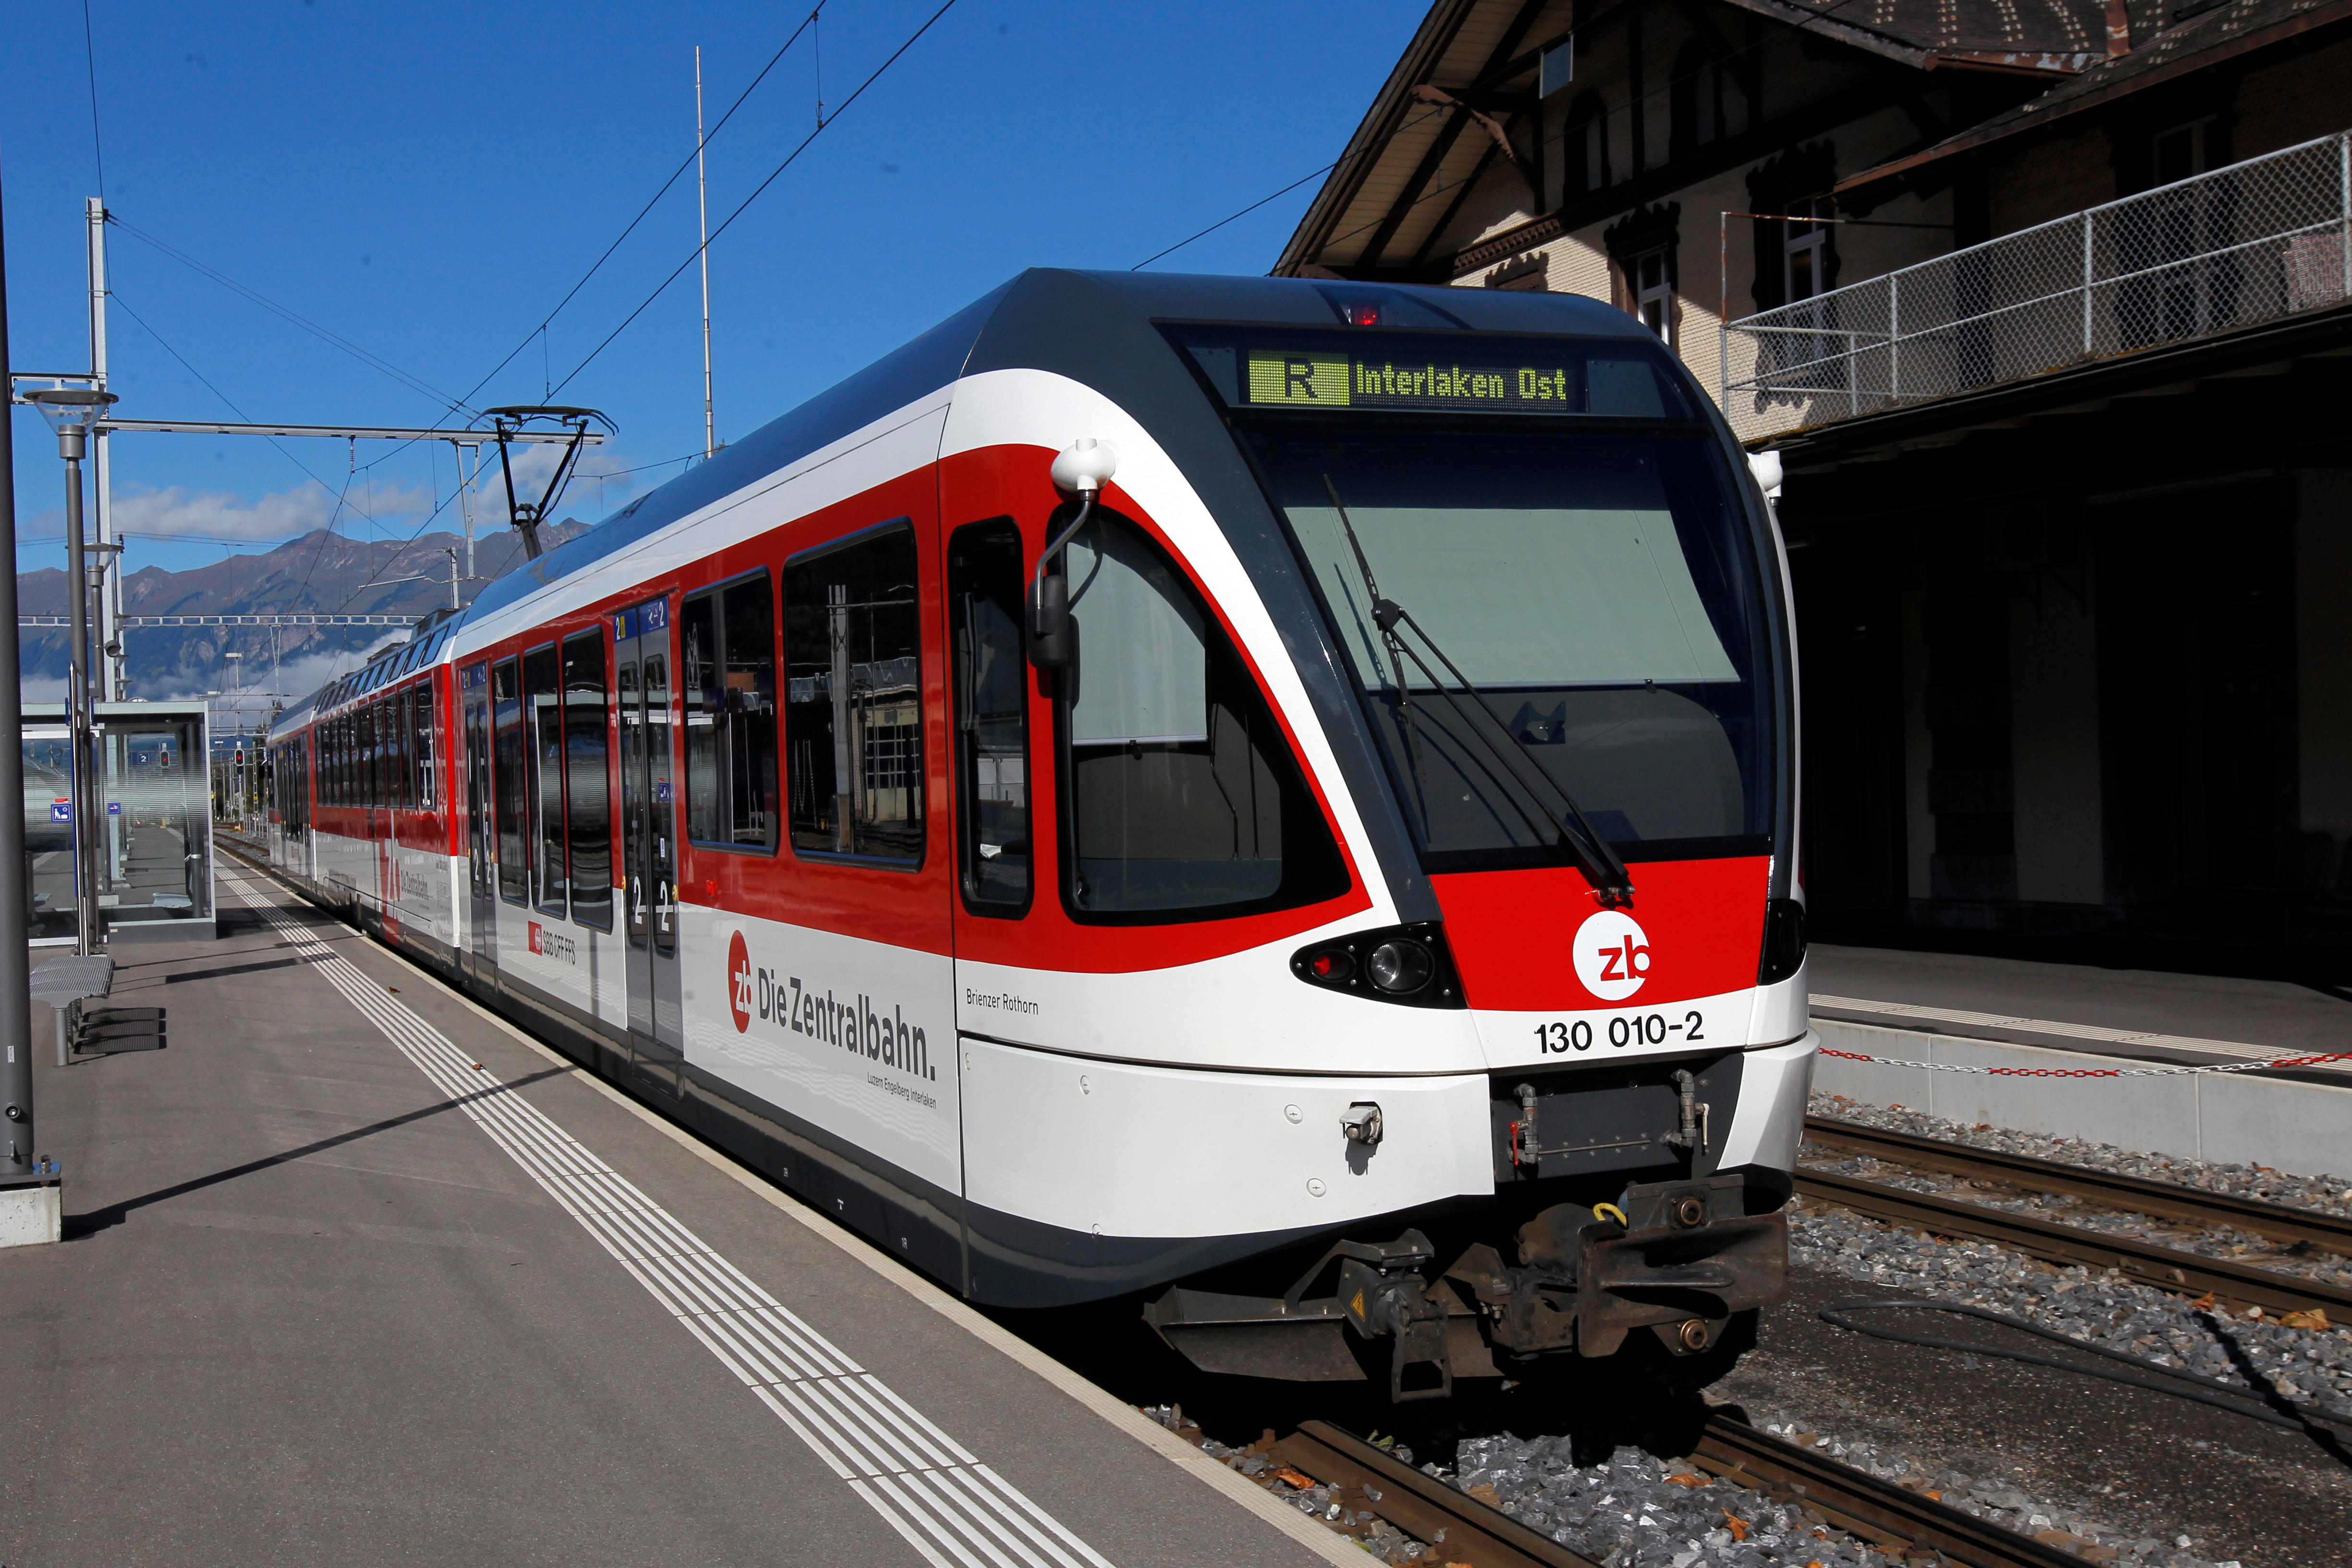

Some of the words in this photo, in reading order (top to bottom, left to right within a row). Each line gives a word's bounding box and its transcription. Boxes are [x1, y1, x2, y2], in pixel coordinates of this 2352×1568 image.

[1284, 356, 1315, 399] R
[1356, 360, 1504, 399] Interlaken
[1519, 368, 1567, 400] Ost
[616, 616, 621, 640] 2
[659, 601, 664, 626] 2
[474, 848, 479, 881] 2
[486, 850, 491, 884] 2
[633, 875, 643, 925] 2
[660, 880, 670, 932] 2
[543, 930, 553, 956] SBB
[554, 933, 564, 960] CFF
[564, 937, 576, 966] FFS
[1597, 934, 1650, 982] zb
[966, 988, 1001, 1009] Brienzer
[1003, 993, 1039, 1016] Rothorn
[735, 960, 752, 1015] zb
[758, 967, 787, 1027] Die
[790, 976, 936, 1081] Zentralbahn.
[1534, 1019, 1592, 1054] 130
[1608, 1010, 1704, 1048] 010-2
[867, 1071, 883, 1089] Luzern
[884, 1077, 910, 1101] Engelberg
[910, 1087, 936, 1110] Interlaken
[784, 1167, 788, 1178] 2R
[901, 1237, 907, 1250] 1R
